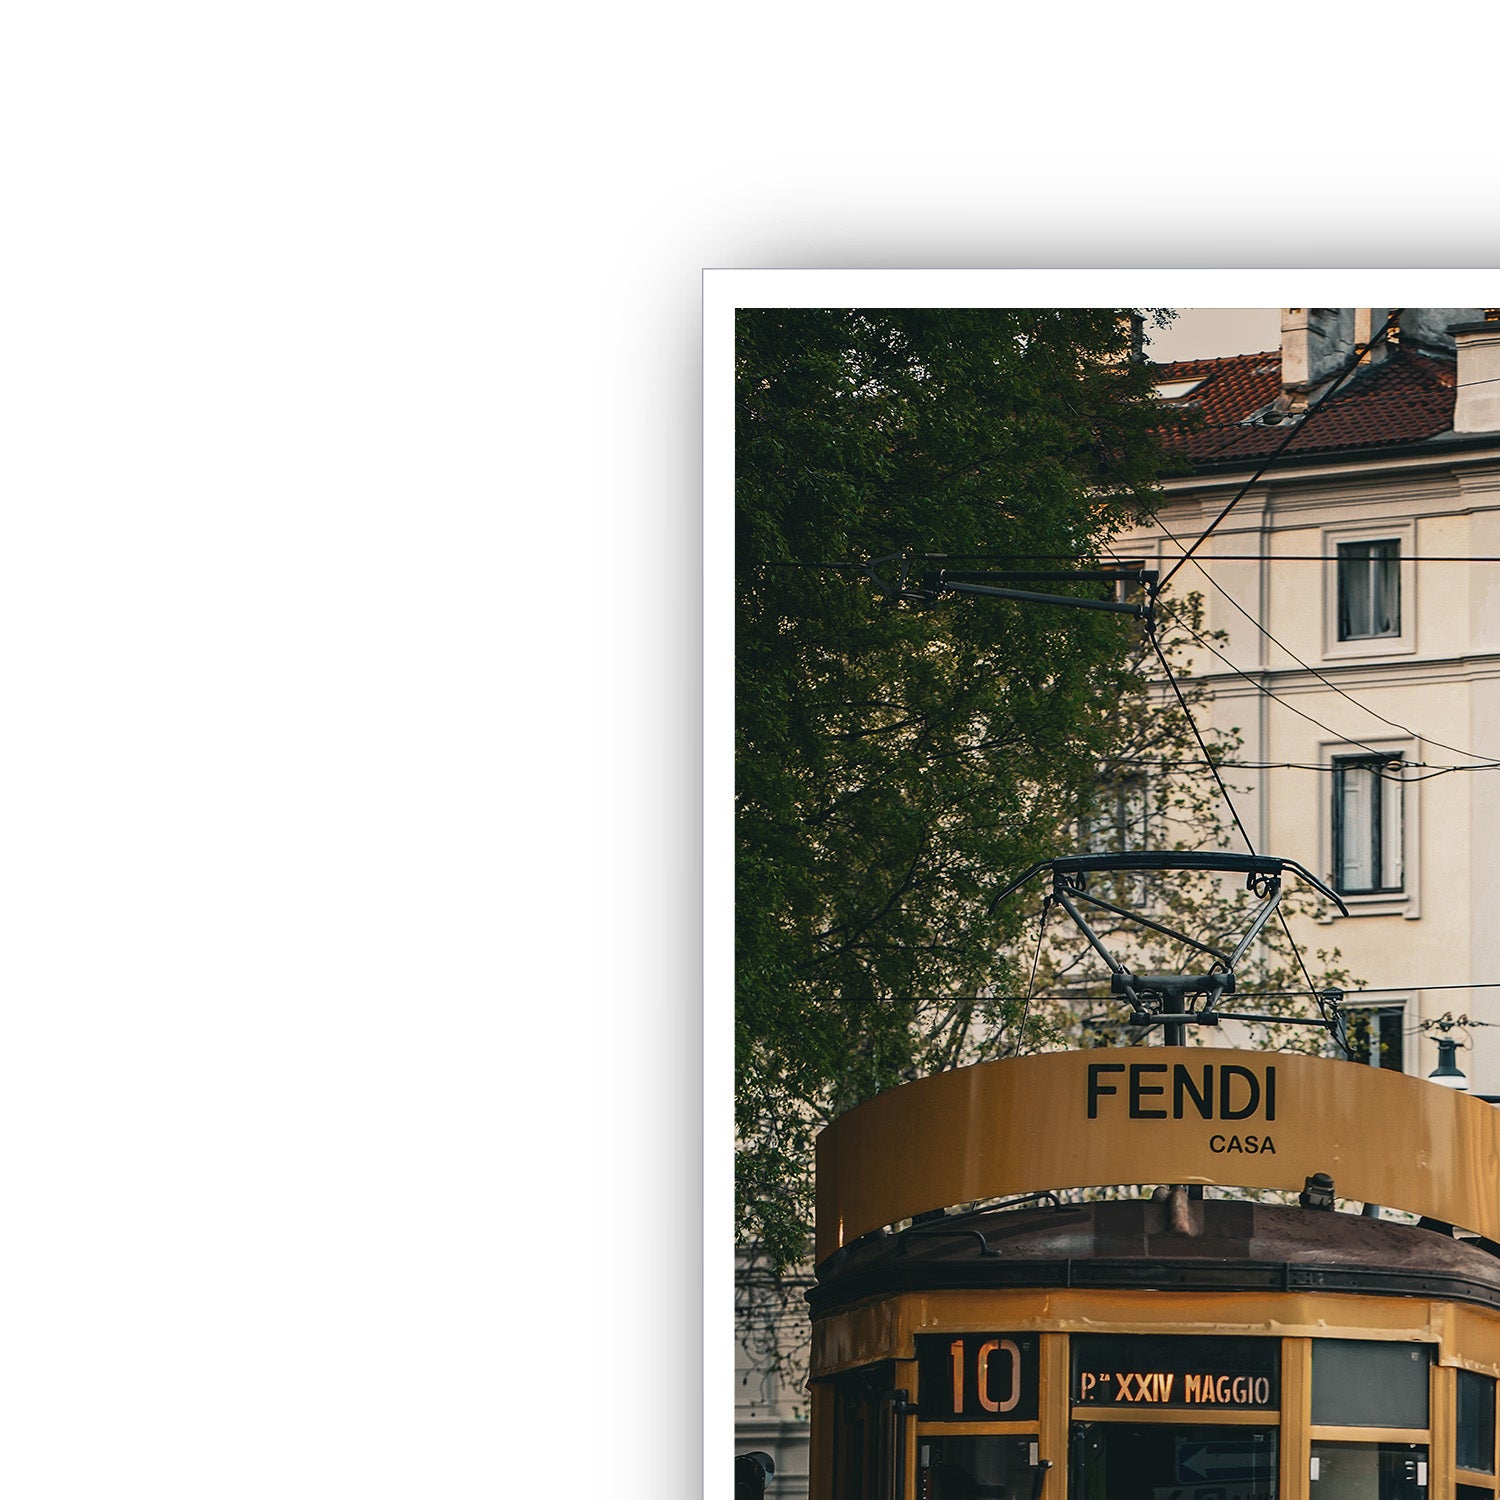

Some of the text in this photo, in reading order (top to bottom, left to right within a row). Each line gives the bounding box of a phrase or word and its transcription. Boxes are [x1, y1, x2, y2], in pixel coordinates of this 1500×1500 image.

[1087, 1063, 1276, 1121] FENDI
[1209, 1134, 1277, 1155] CASA
[950, 1339, 1021, 1414] 10
[1115, 1373, 1174, 1403] XXIV
[1184, 1374, 1270, 1404] MAGGIO
